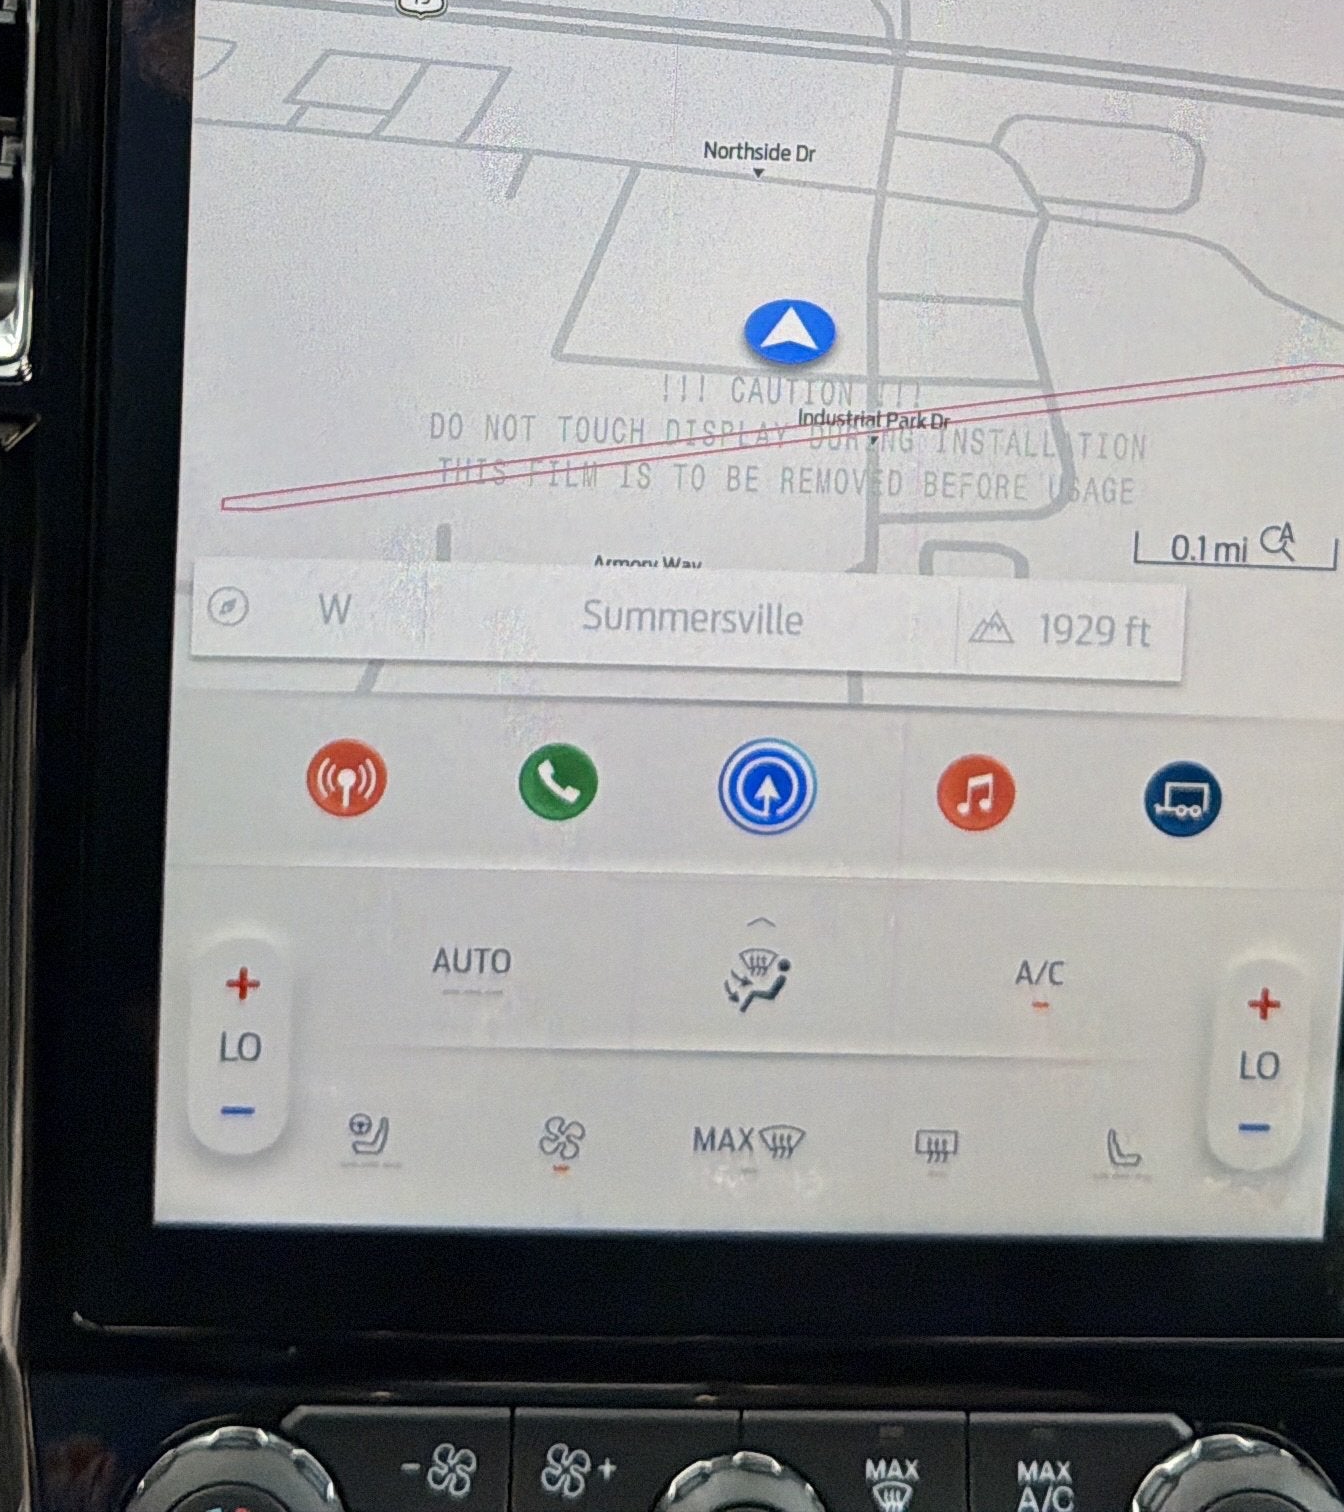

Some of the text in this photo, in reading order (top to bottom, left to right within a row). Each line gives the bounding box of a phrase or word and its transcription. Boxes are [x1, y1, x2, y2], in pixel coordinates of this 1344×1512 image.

[703, 140, 816, 163] Northside Dr
[730, 376, 853, 407] CAUTION
[798, 407, 951, 430] Industrial Park Dr
[429, 412, 1148, 461] DO NOT TOUCH DISPLAY DURNG INSTALLTION
[438, 457, 507, 487] THIS
[529, 459, 599, 489] FILM
[621, 462, 653, 490] IS
[673, 463, 706, 491] TO
[727, 464, 759, 493] BE
[781, 466, 903, 497] REMOVED
[923, 471, 1028, 502] BEFORE
[1171, 534, 1206, 561] 0.1
[1213, 536, 1248, 563] mi
[319, 592, 352, 626] W
[582, 598, 805, 636] Summersville
[1040, 613, 1152, 648] 1929 ft
[432, 947, 512, 975] AUTO
[1015, 959, 1065, 987] A/C
[219, 1031, 262, 1062] LO
[1239, 1050, 1281, 1081] LO
[693, 1126, 754, 1154] MAX
[864, 1458, 920, 1482] MAX
[1017, 1460, 1073, 1485] MAX
[1017, 1484, 1076, 1512] A/C
